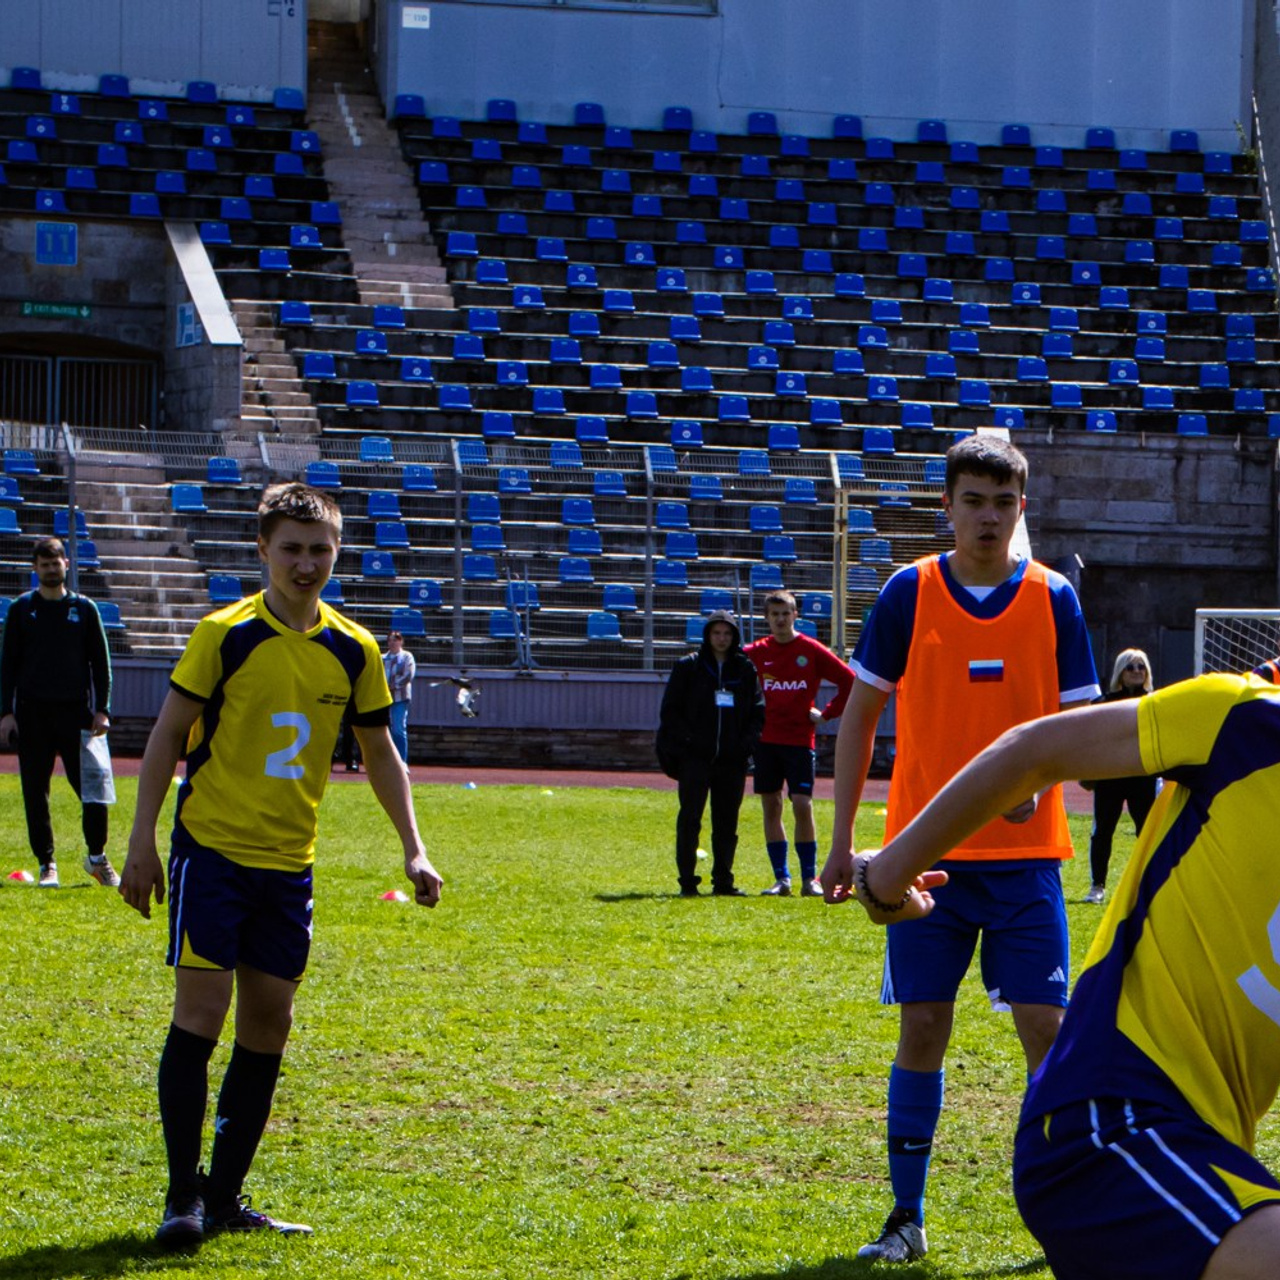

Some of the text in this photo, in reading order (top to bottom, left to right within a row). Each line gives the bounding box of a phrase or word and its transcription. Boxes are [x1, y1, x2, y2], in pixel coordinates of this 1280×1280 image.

[45, 233, 70, 253] 11
[763, 679, 808, 691] FAMA
[264, 711, 311, 779] 2
